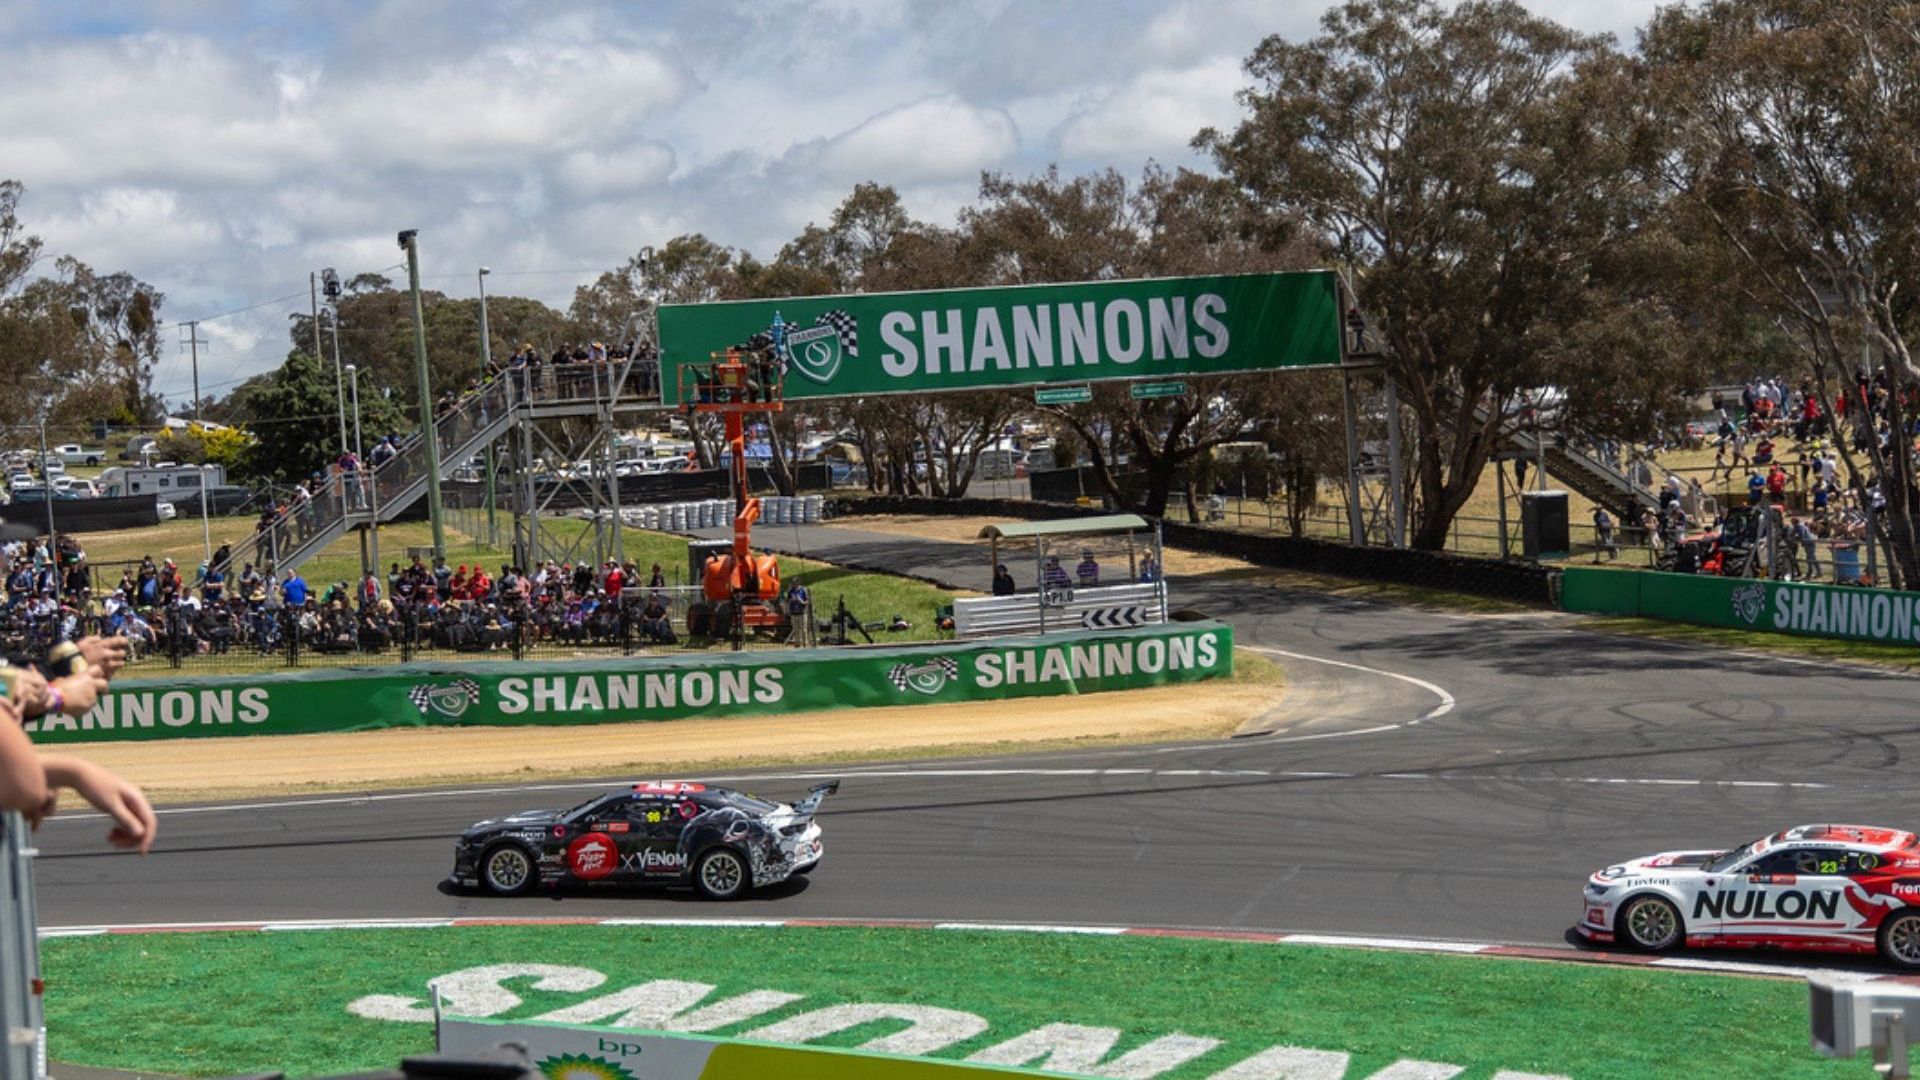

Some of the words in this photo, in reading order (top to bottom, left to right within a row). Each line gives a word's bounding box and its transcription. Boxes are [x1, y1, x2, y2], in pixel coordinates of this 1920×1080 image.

[880, 293, 1230, 377] SHANNONS
[975, 633, 1218, 688] SHANNONS
[498, 668, 784, 714] SHANNONS
[24, 687, 270, 732] ANNONS
[577, 852, 606, 865] Pizza
[582, 860, 604, 872] Hut
[636, 846, 688, 870] VENOM
[1820, 861, 1838, 874] 23
[1692, 890, 1841, 920] NULON
[598, 1037, 642, 1057] bp
